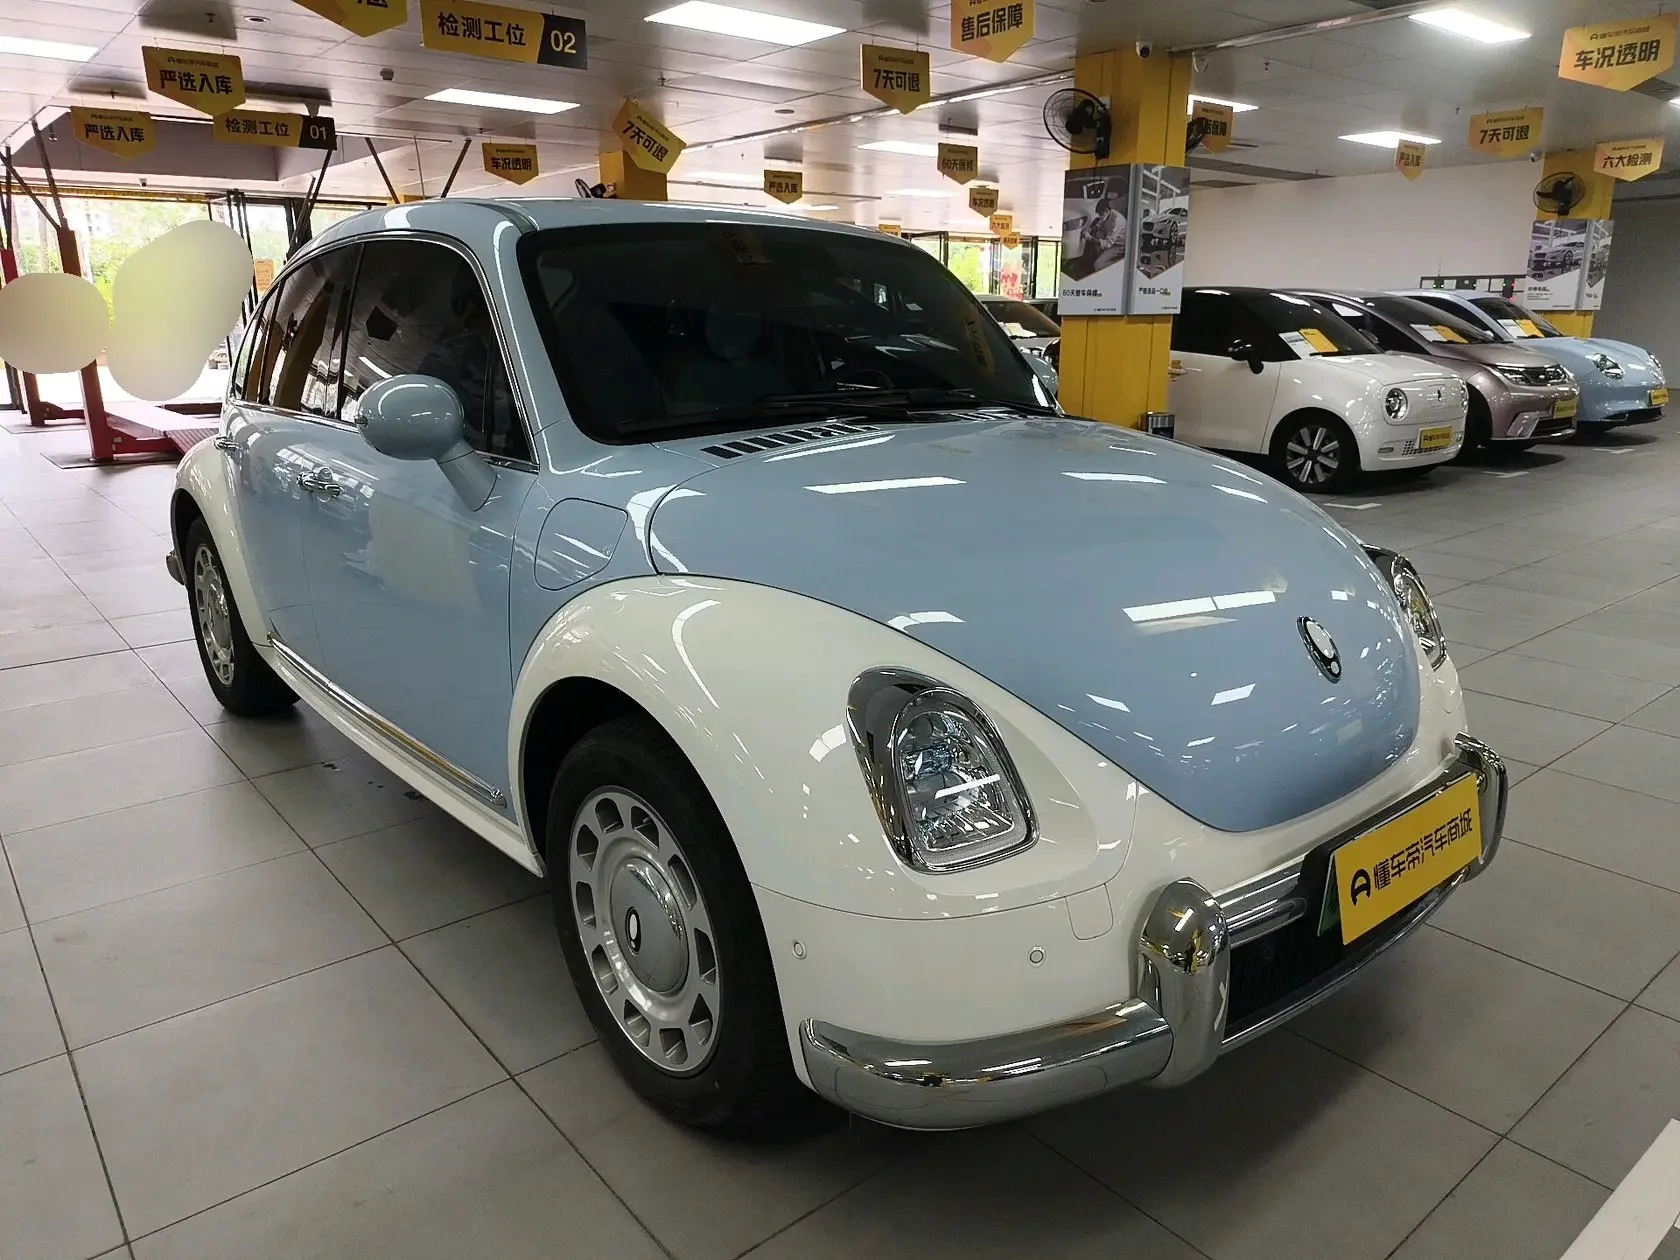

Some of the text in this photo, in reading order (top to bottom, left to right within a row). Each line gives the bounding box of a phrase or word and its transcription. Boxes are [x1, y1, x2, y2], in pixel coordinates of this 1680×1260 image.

[437, 11, 577, 54] 检测工位 02
[961, 2, 1023, 42] 售后保障
[1573, 38, 1661, 71] 车况透明
[159, 69, 233, 94] 严选入库
[873, 68, 920, 93] 7天可退
[84, 123, 145, 143] 严选入库
[225, 117, 327, 140] 检测工位 01
[1479, 124, 1530, 145] 7天可退
[622, 120, 669, 163] 7天可退
[490, 156, 532, 171] 车况透明
[1602, 152, 1653, 169] 六大检测
[1373, 807, 1473, 891] 懂车帝汽车商城
